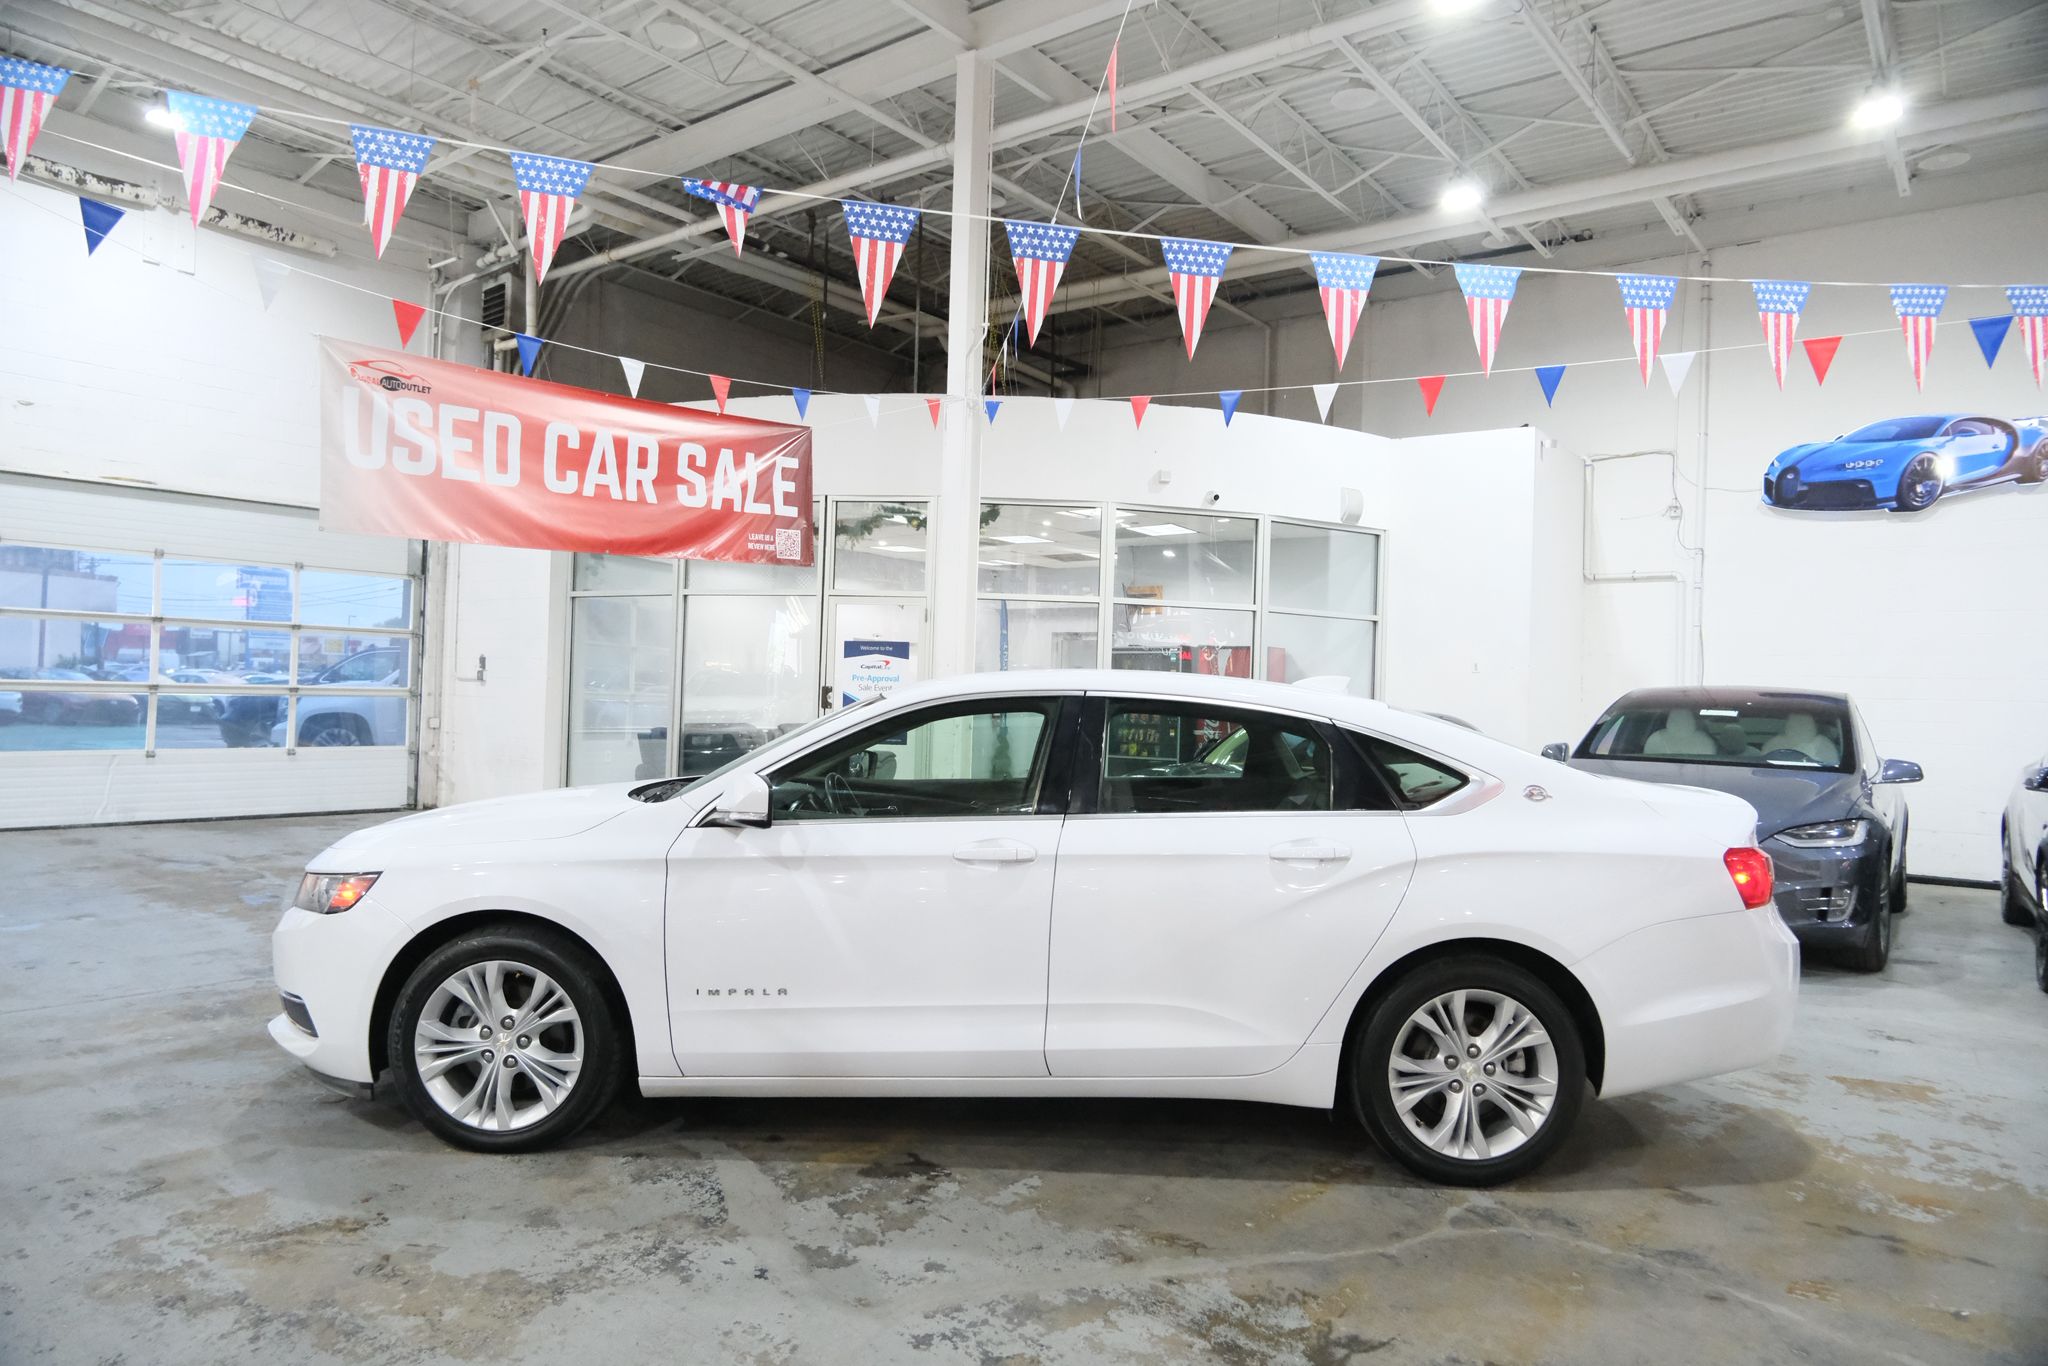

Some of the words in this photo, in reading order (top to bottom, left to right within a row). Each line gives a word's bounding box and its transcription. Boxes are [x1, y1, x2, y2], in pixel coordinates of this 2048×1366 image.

[343, 386, 521, 487] USED
[543, 421, 659, 504] CAR
[676, 442, 799, 518] SALE
[748, 533, 764, 541] LEAVE
[851, 674, 900, 683] Pre-Approval
[874, 684, 893, 692] Event
[696, 988, 788, 996] IMPALA
